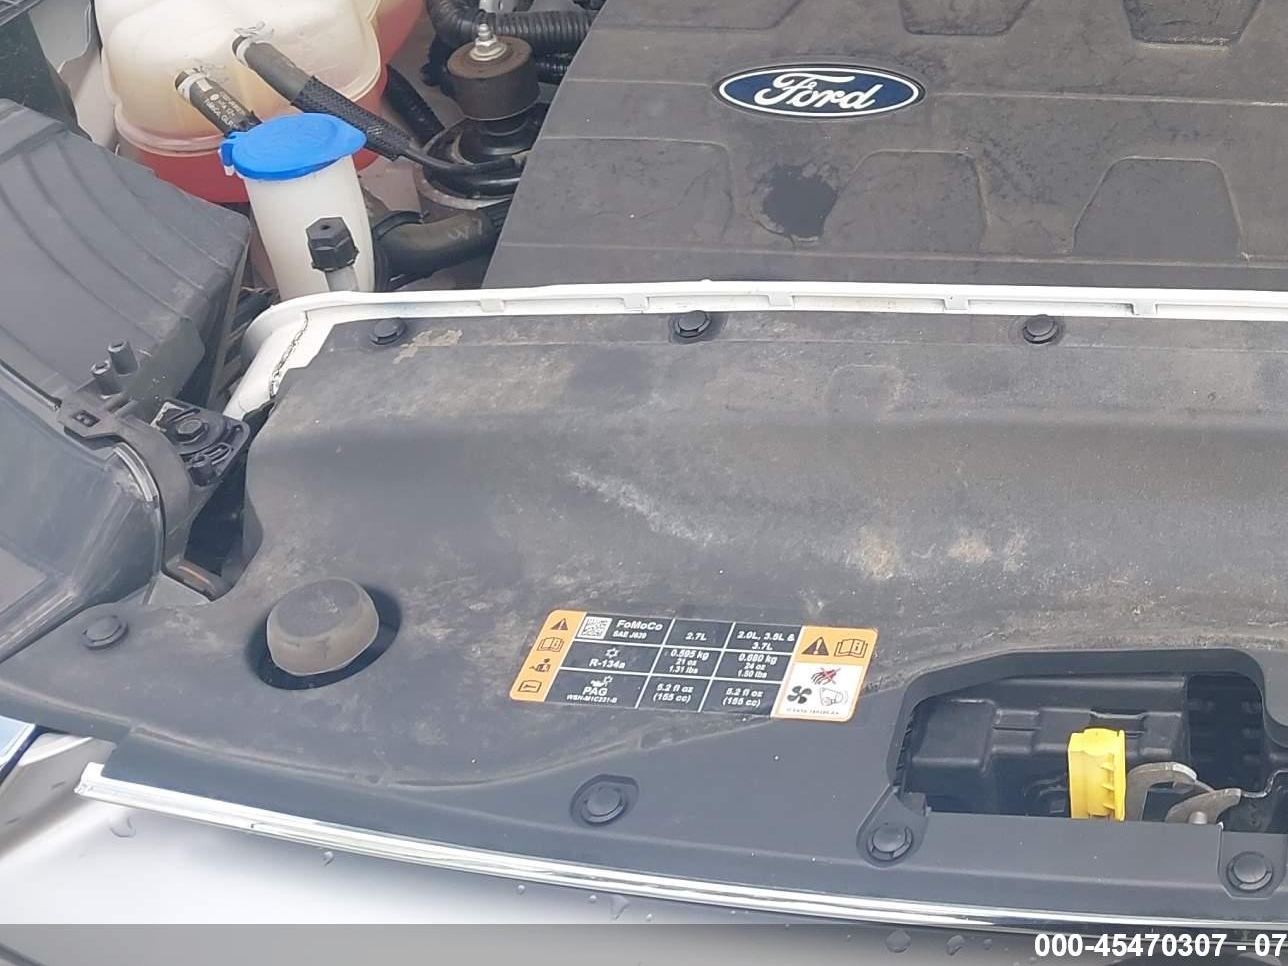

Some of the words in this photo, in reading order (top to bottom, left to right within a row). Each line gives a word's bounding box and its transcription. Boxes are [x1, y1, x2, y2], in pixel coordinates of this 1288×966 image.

[754, 72, 884, 109] Ford
[616, 619, 663, 631] FoMoCo
[685, 632, 707, 641] 2.7L
[751, 641, 773, 651] 3.7L
[697, 650, 710, 661] kg
[765, 654, 778, 665] kg
[588, 658, 626, 669] R-134a
[675, 658, 686, 666] 21
[744, 662, 755, 670] 24
[669, 665, 685, 674] 1.31
[685, 666, 699, 674] lbs
[754, 670, 767, 679] lbs
[582, 686, 608, 696] PAG
[673, 683, 681, 692] fl
[681, 685, 694, 693] oz
[742, 688, 750, 697] fl
[675, 694, 691, 703] cc)
[745, 697, 761, 707] cc)
